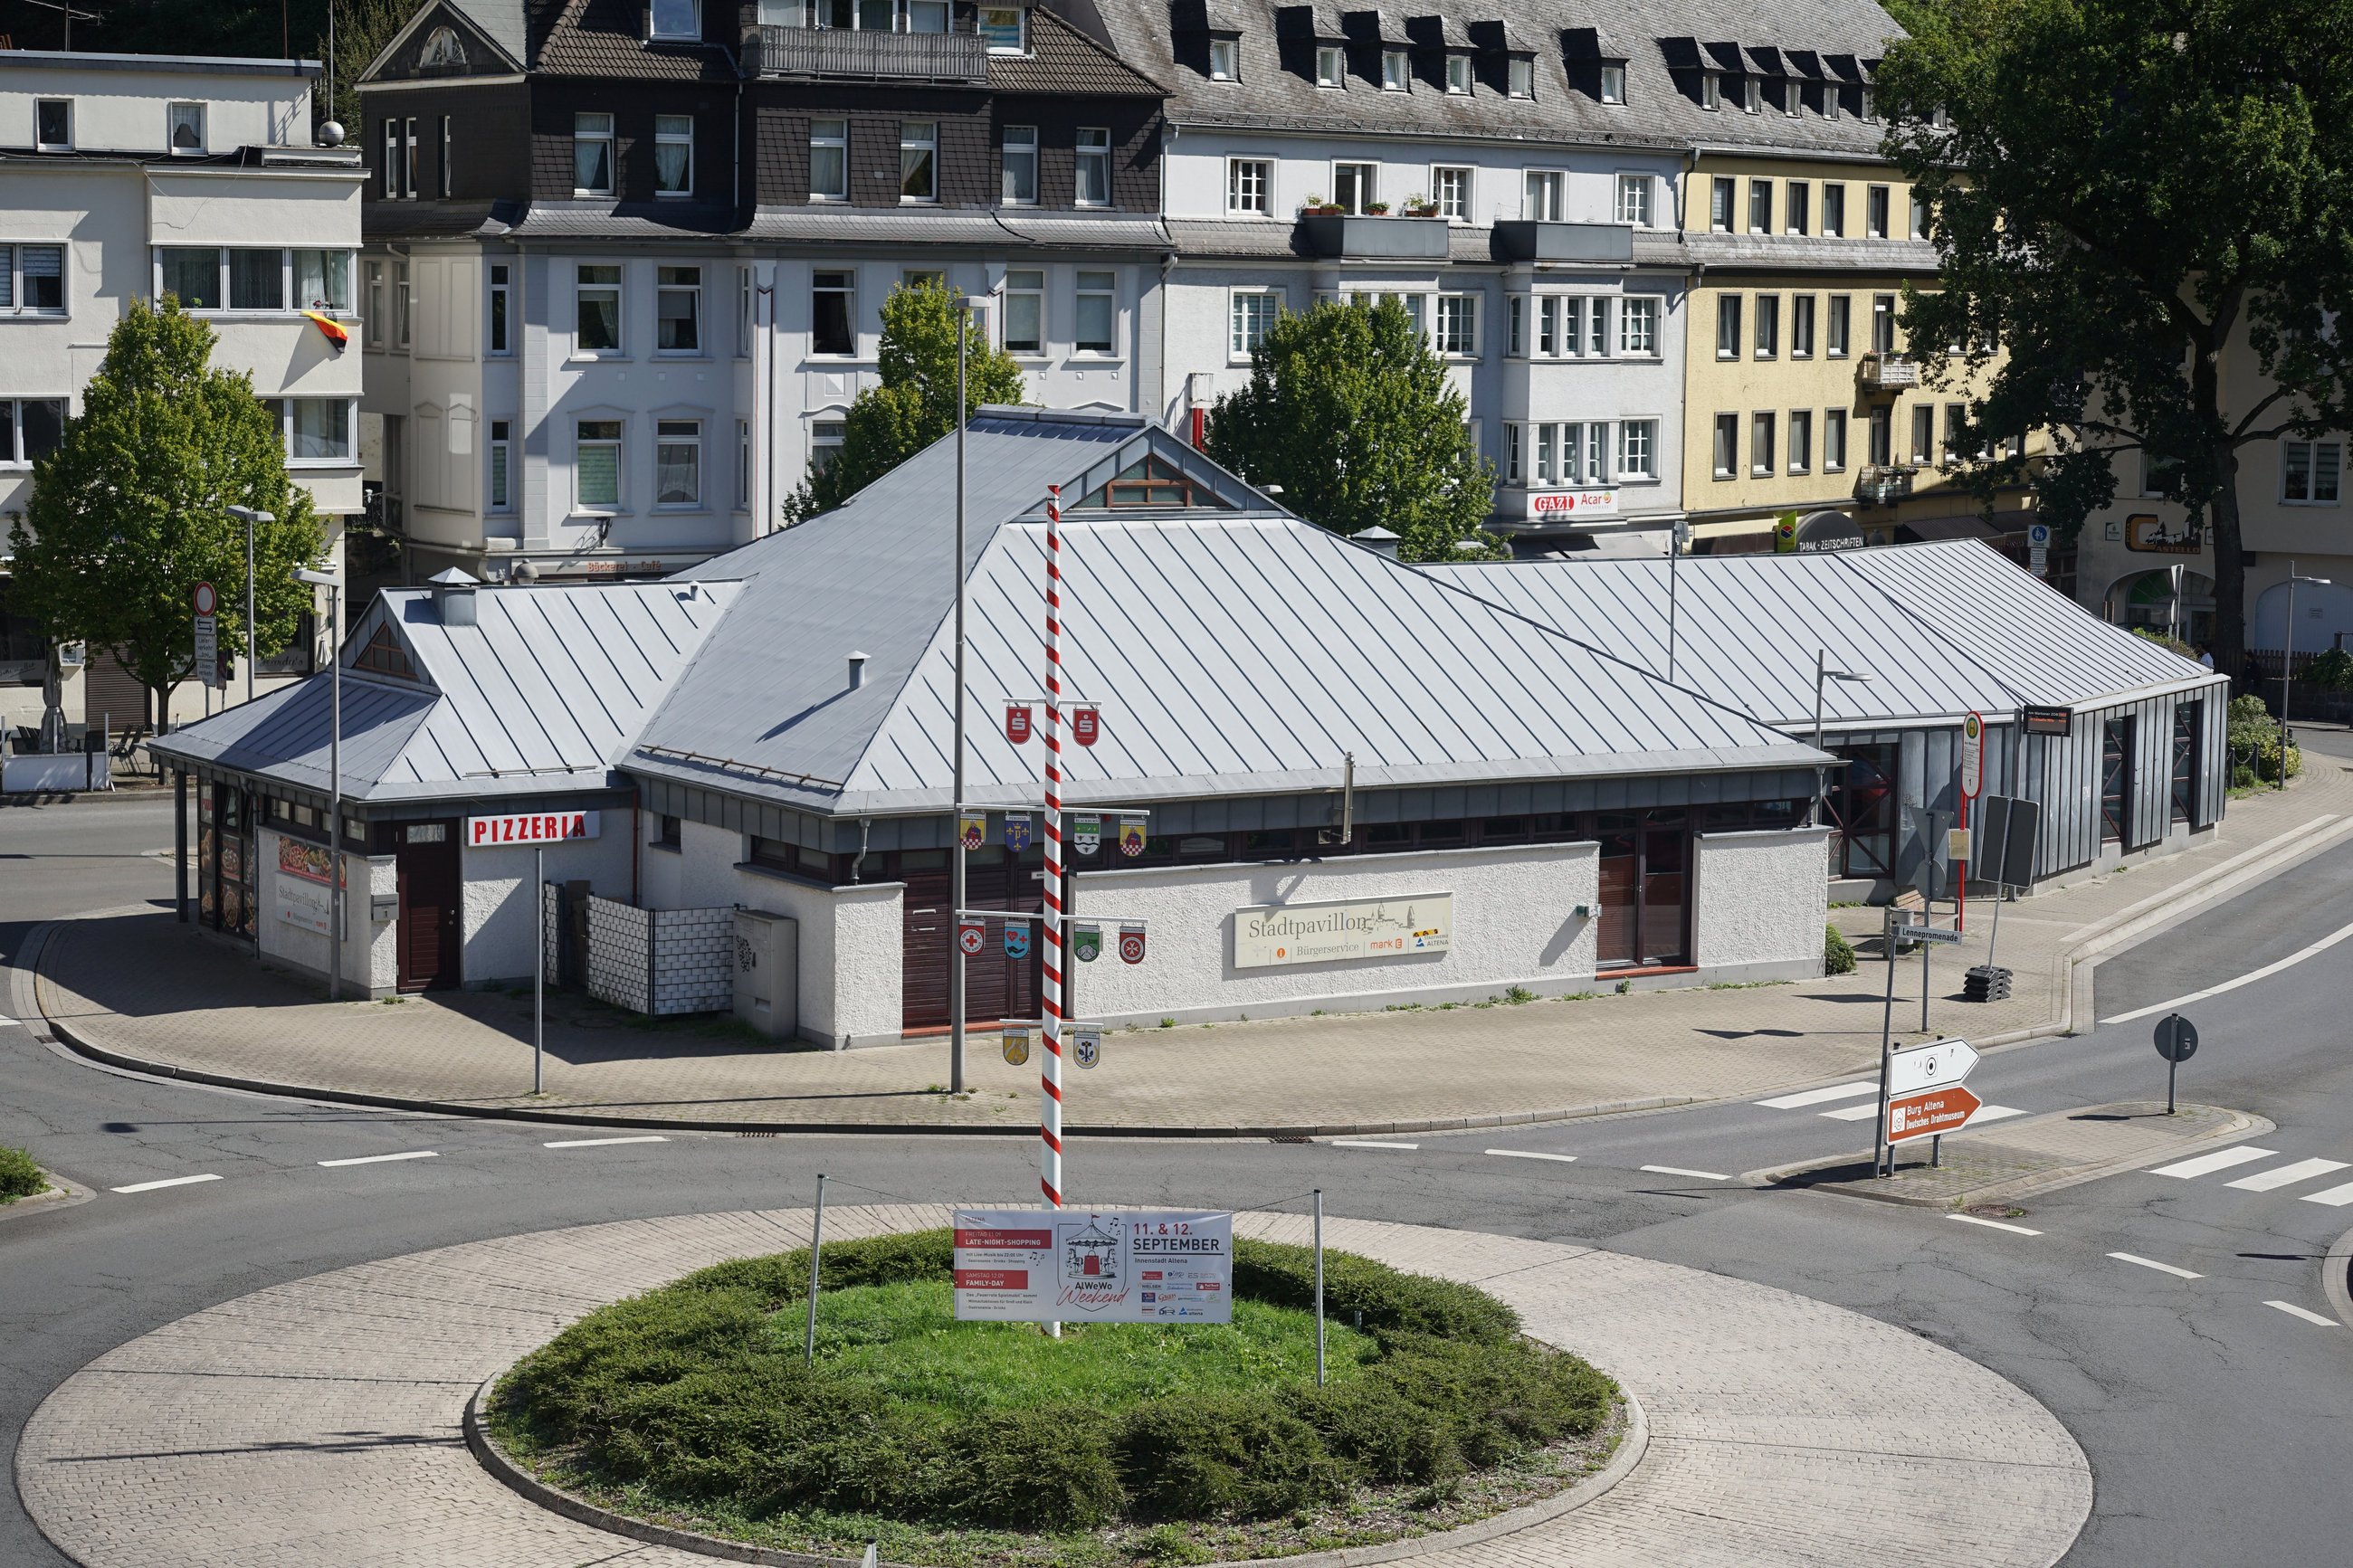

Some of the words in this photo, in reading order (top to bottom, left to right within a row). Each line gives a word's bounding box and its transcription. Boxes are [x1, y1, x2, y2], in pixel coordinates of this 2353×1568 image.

[1538, 497, 1571, 511] GAZI
[1581, 493, 1602, 505] Acar
[1799, 542, 1817, 552] TABAK
[1821, 537, 1864, 550] ZEITSCHRIFTEN
[587, 561, 628, 572] Bäckerei
[642, 560, 662, 571] Café
[474, 814, 586, 843] PIZZERIA
[279, 886, 318, 908] Stadtpavillon
[1249, 912, 1367, 940] Stadtpavillon
[1902, 927, 1958, 942] Lennepromenade
[1297, 943, 1359, 959] Bürgerservice
[1370, 939, 1393, 950] mark
[1907, 1106, 1921, 1117] Burg
[1924, 1100, 1945, 1112] Altena
[1906, 1117, 1929, 1130] Deutsches
[1930, 1110, 1965, 1125] Drahtmuseum
[1134, 1222, 1154, 1235] 11.
[1158, 1223, 1168, 1235] &
[1174, 1223, 1193, 1236] 12.
[1133, 1239, 1220, 1250] SEPTEMBER
[1075, 1281, 1113, 1290] AlWeWo
[1056, 1285, 1130, 1307] Weekend
